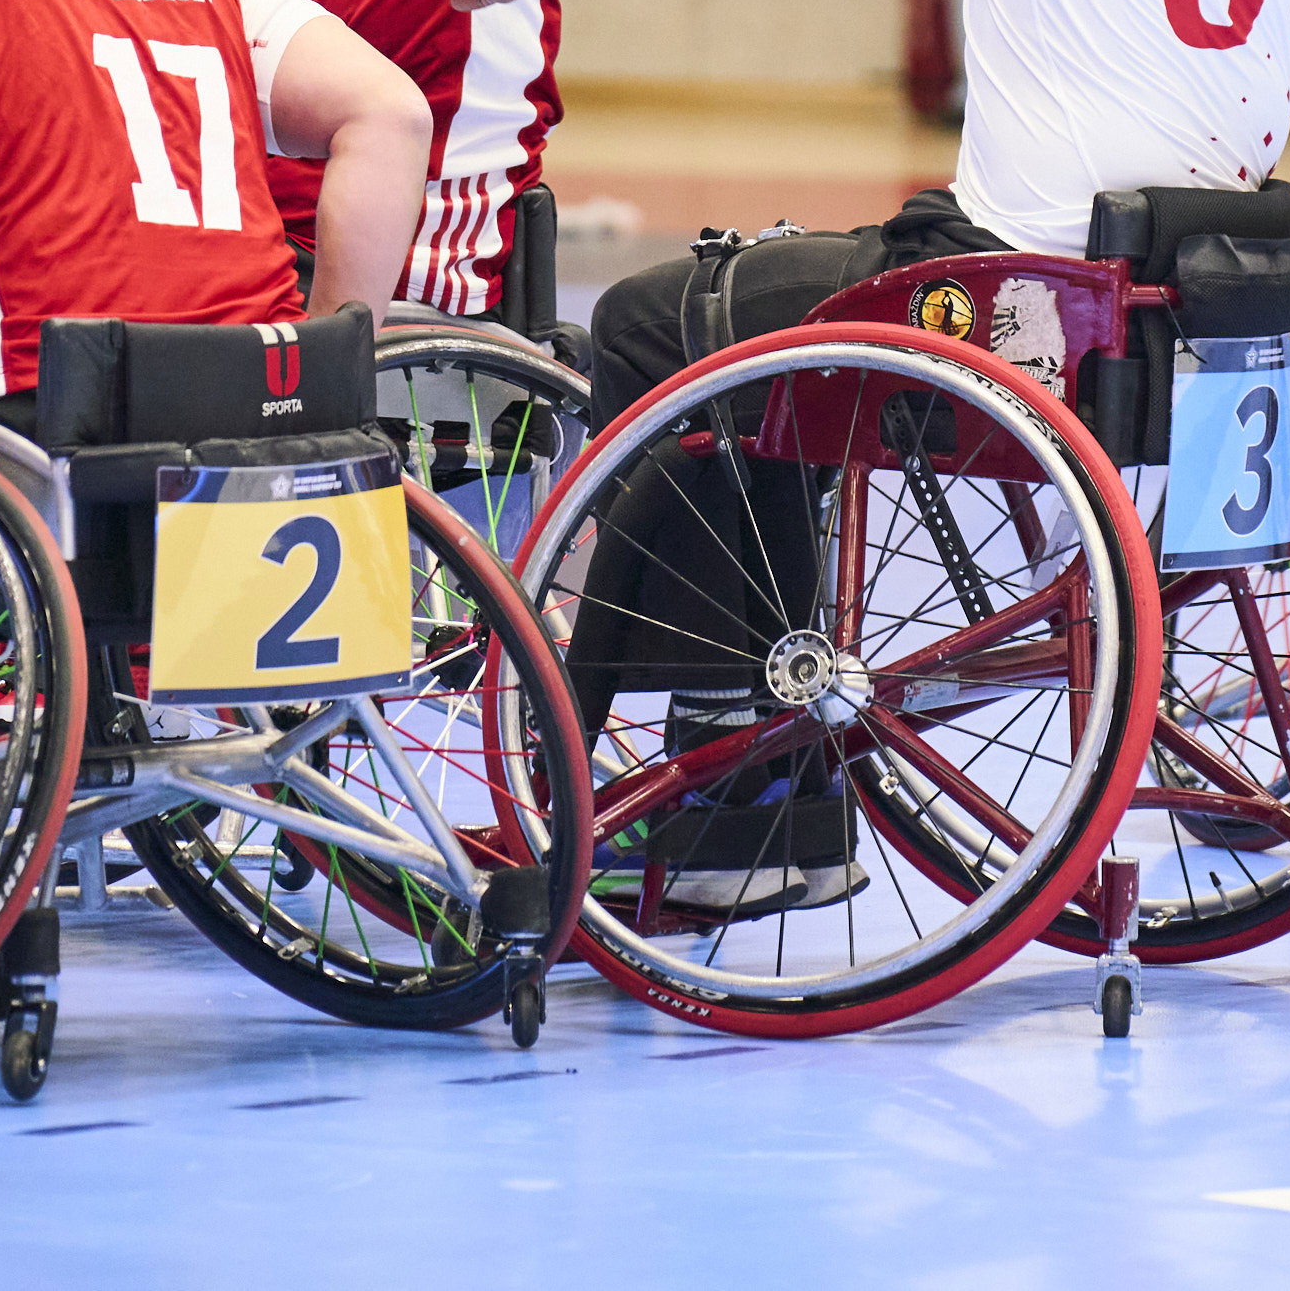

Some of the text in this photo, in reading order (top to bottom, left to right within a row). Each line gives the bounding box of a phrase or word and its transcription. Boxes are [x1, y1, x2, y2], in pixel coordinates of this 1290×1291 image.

[93, 33, 243, 233] 17
[910, 291, 925, 329] ARAŽDIN
[261, 397, 303, 418] SPORTA
[1221, 383, 1280, 539] 3
[254, 514, 343, 673] 2
[647, 987, 711, 1018] KENDA
